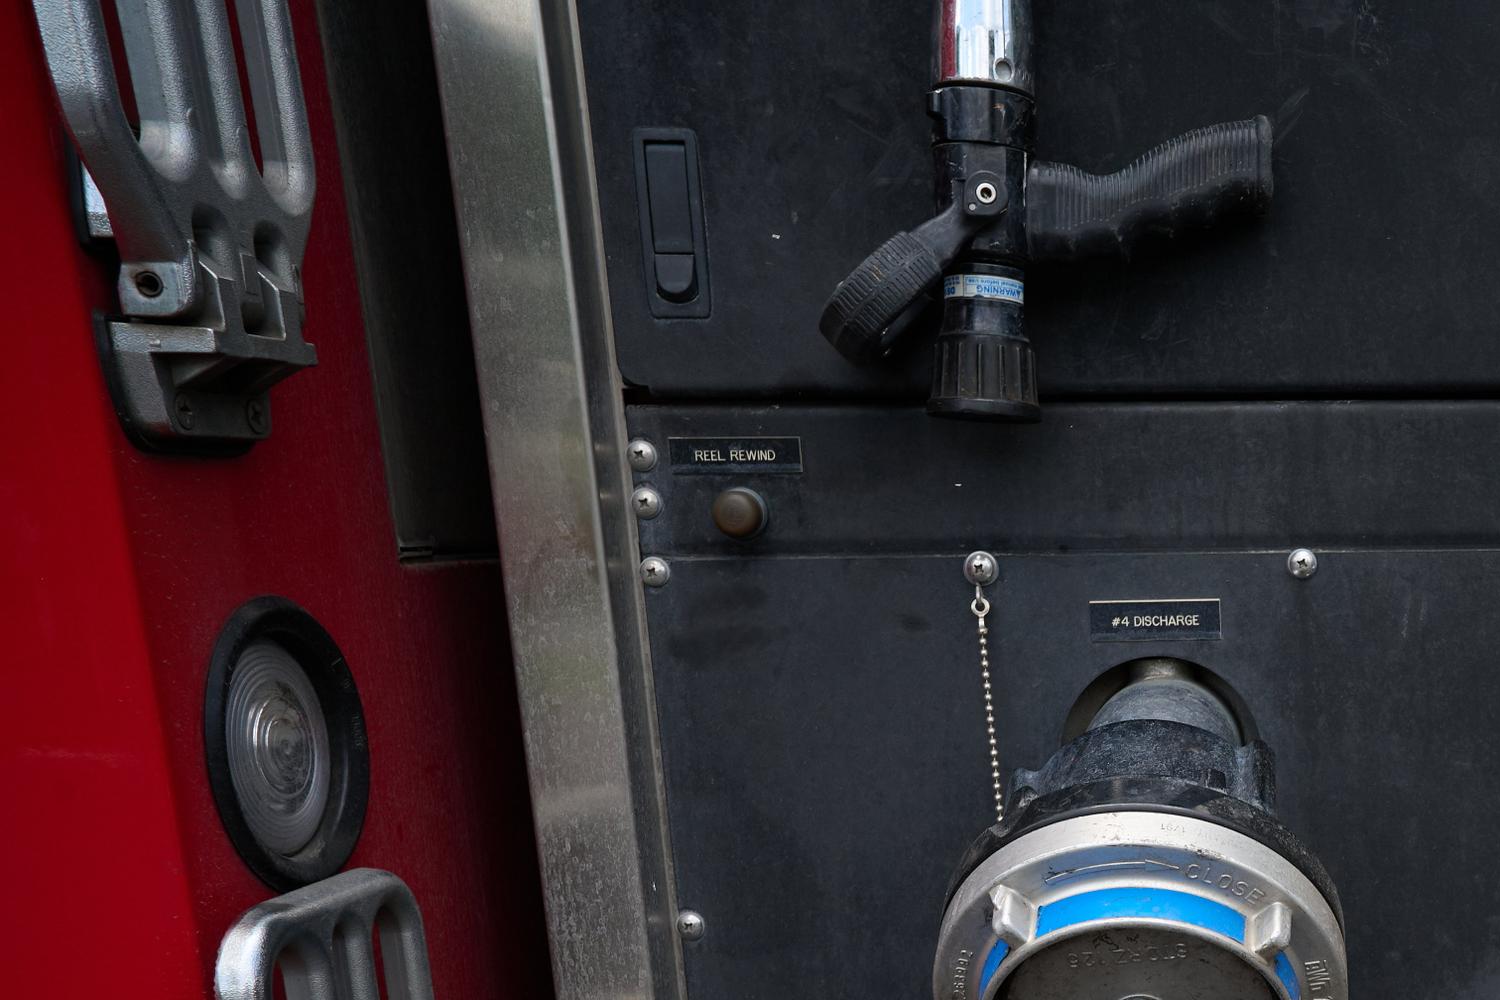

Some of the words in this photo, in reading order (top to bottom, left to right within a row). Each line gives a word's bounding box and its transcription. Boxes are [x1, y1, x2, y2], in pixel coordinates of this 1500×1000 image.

[976, 284, 1016, 297] WARNING
[694, 449, 726, 461] REEL
[729, 449, 776, 461] REWIND
[1111, 616, 1129, 628] #4
[1133, 614, 1200, 627] DISCHARGE
[1184, 863, 1265, 905] CLOSE
